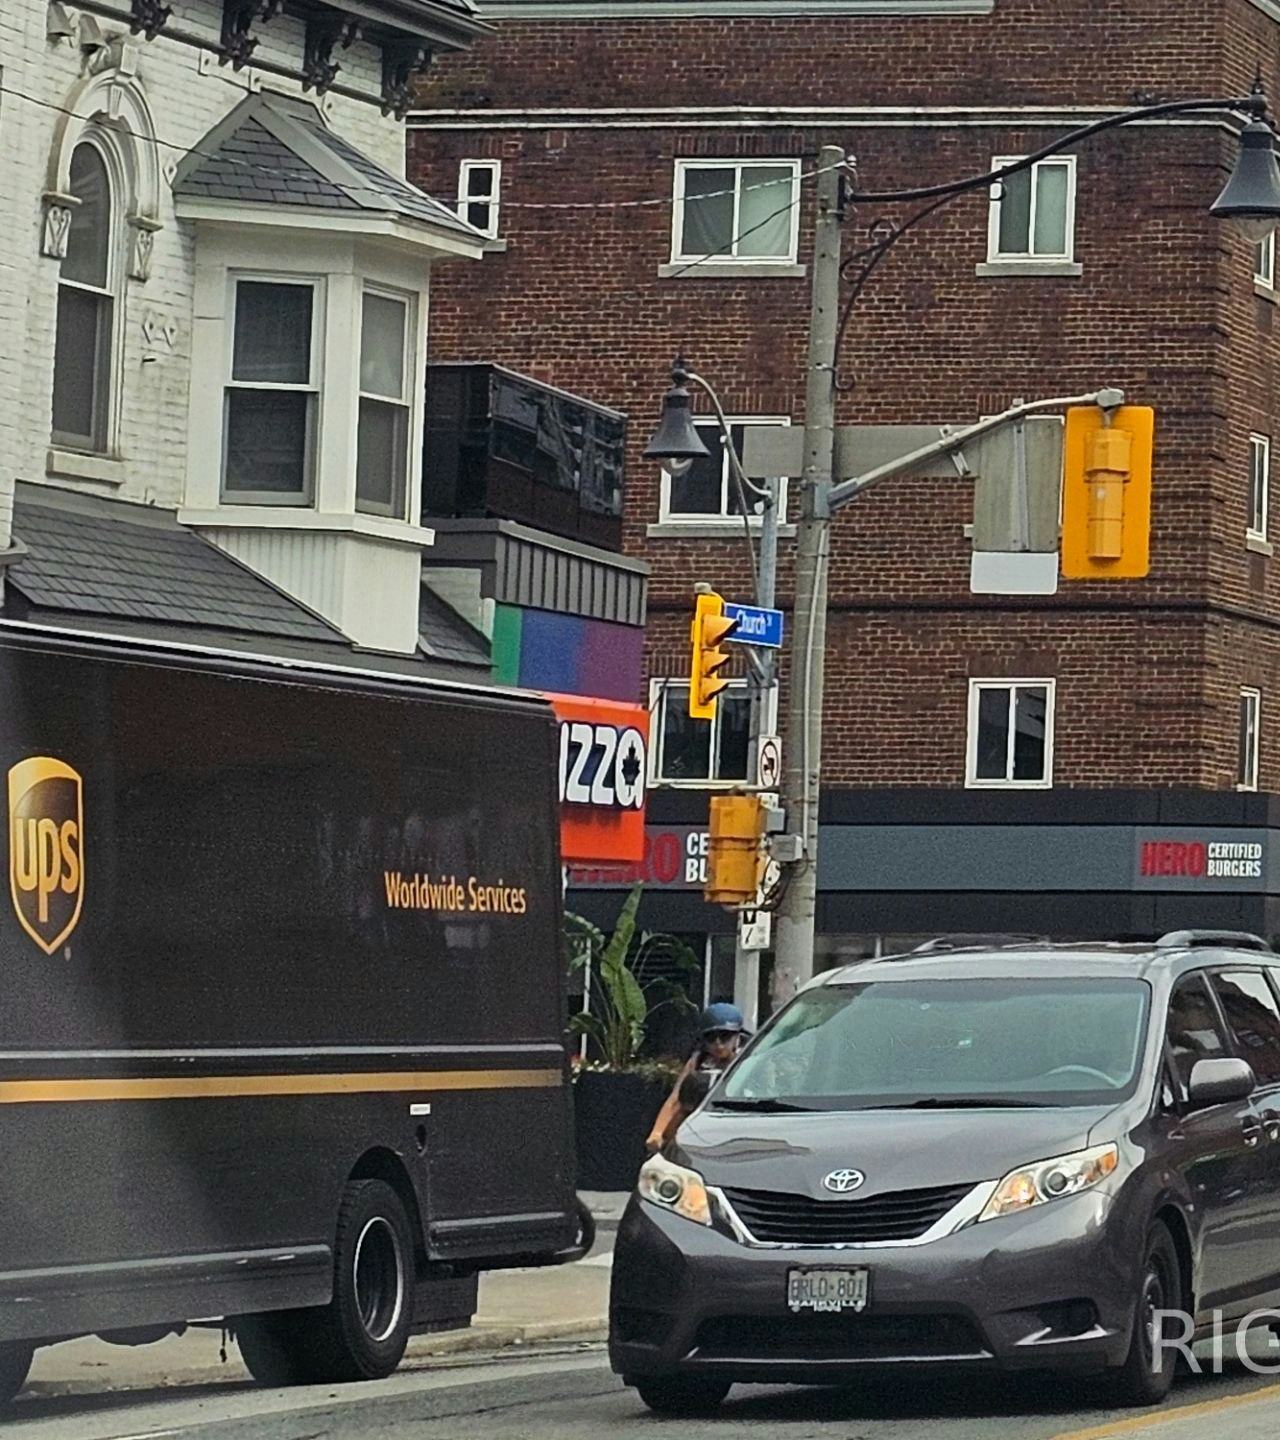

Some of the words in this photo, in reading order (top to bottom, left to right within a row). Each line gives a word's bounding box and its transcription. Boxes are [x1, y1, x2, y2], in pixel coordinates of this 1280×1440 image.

[736, 610, 766, 636] Church
[16, 817, 79, 923] ups
[1141, 841, 1206, 877] HERO
[1207, 842, 1262, 859] CERTIFIED
[1207, 860, 1261, 877] BURGERS
[384, 871, 465, 911] Worldwide
[468, 876, 526, 914] Services
